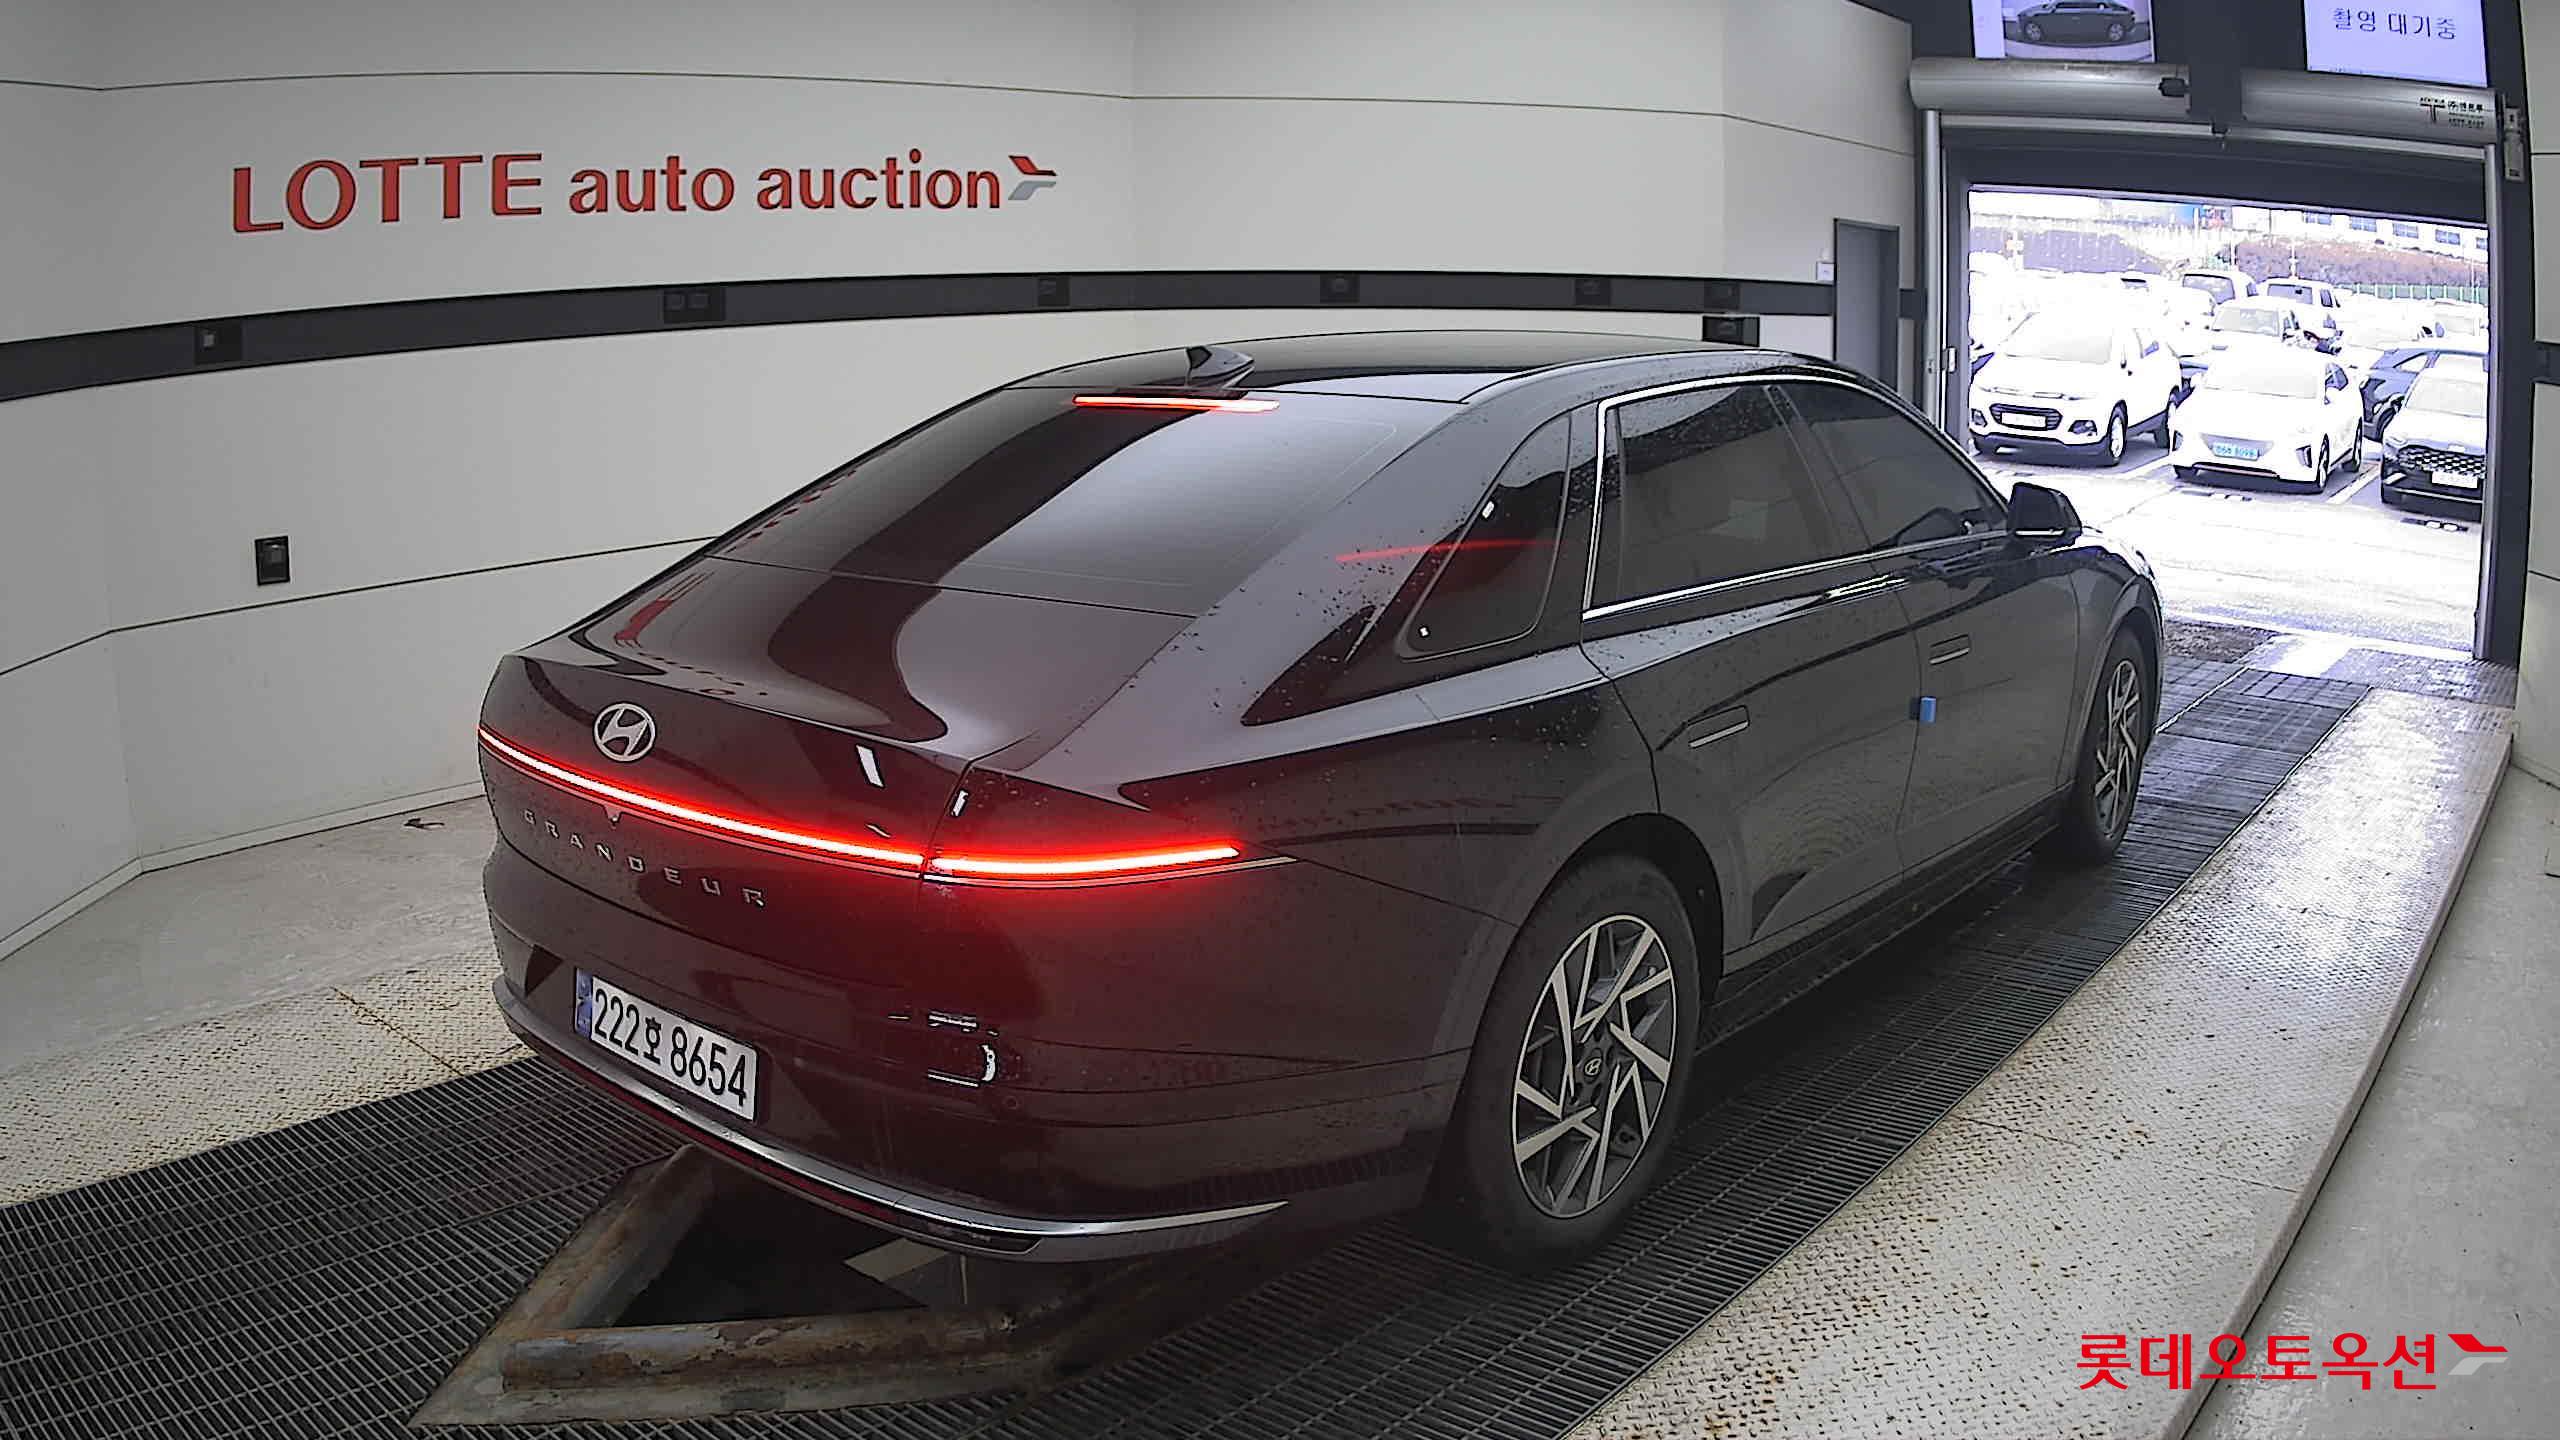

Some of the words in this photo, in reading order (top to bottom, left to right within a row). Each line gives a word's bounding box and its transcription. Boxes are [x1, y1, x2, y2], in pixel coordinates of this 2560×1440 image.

[2333, 8, 2376, 32] 촬영
[2388, 13, 2456, 40] 대기중
[233, 153, 542, 233] LOTTE
[568, 155, 735, 213] auto
[756, 148, 1001, 210] auction
[523, 808, 766, 907] GRANDEUR
[594, 988, 662, 1066] 222호
[670, 1026, 747, 1107] 8654
